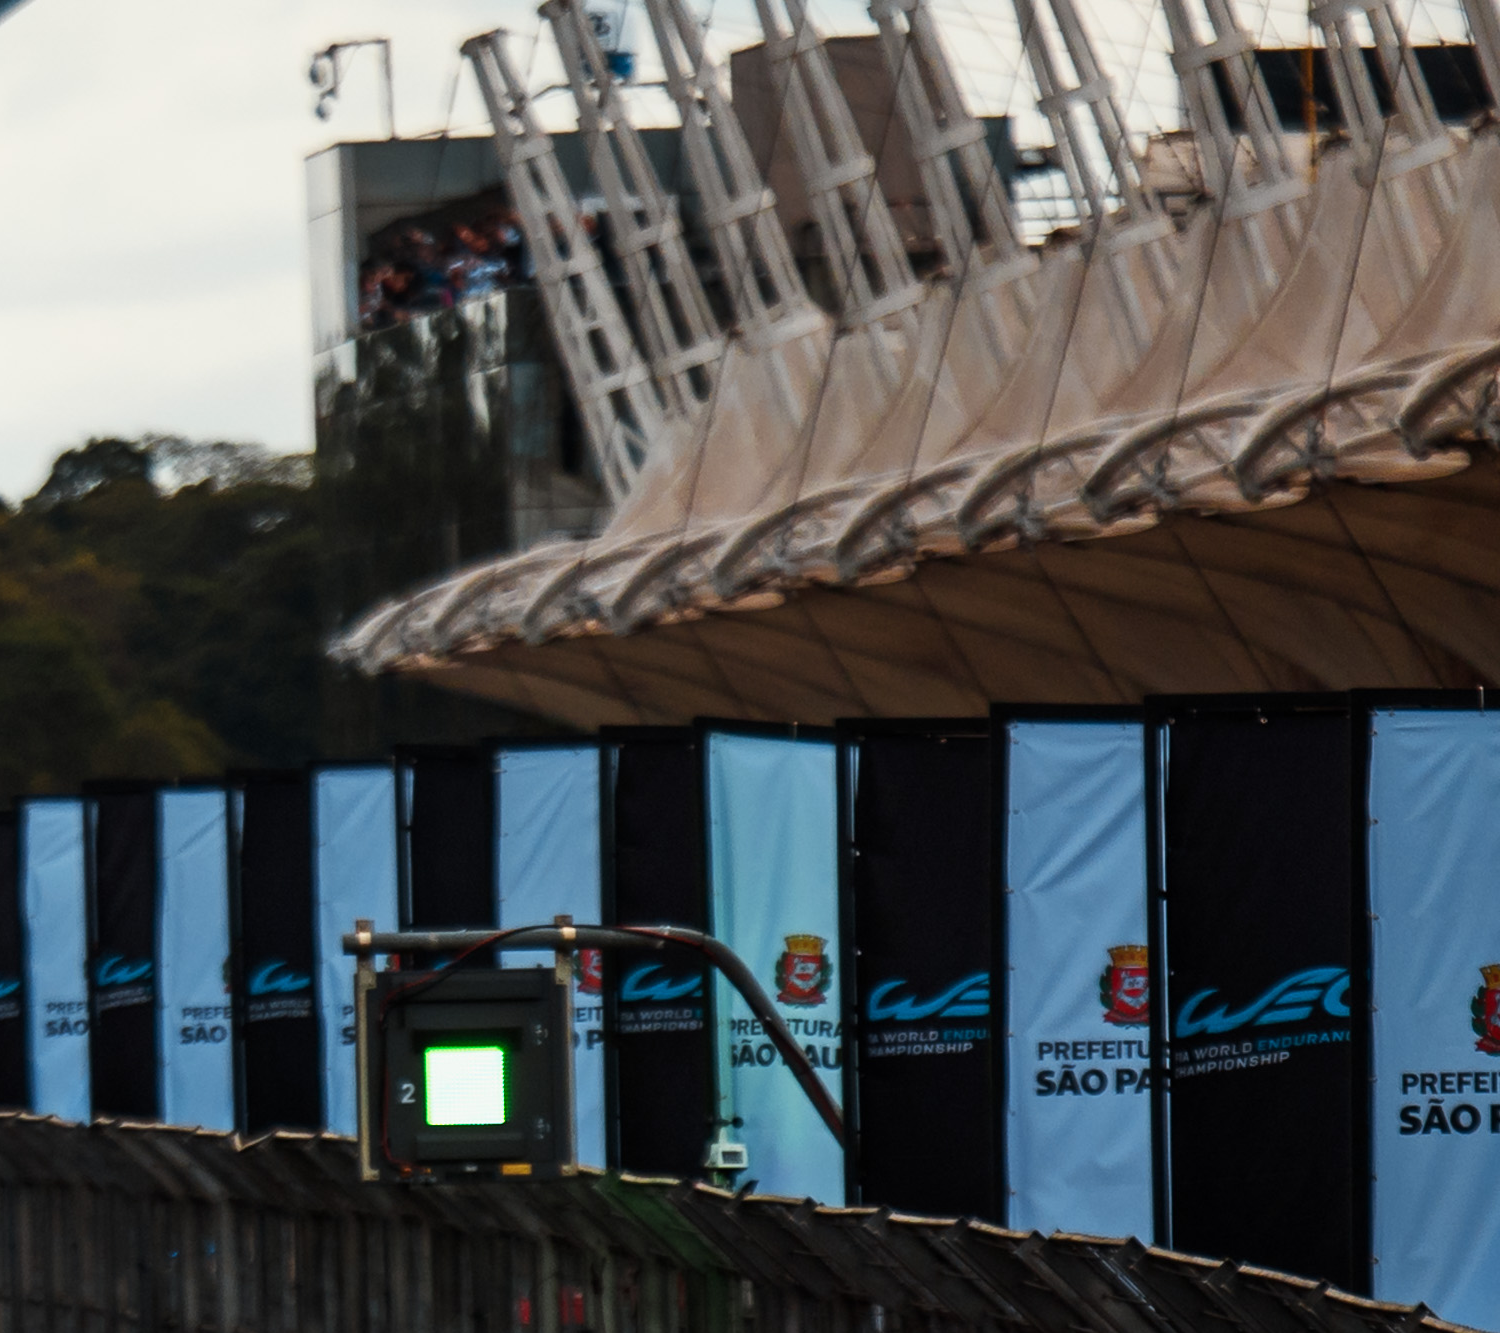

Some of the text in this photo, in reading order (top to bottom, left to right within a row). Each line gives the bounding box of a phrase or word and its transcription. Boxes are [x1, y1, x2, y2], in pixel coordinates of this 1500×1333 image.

[882, 1030, 940, 1044] WORLD
[1194, 1042, 1254, 1061] WORLD
[1035, 1063, 1109, 1097] SÃO
[400, 1083, 417, 1105] 2
[1398, 1098, 1482, 1136] SÃO
